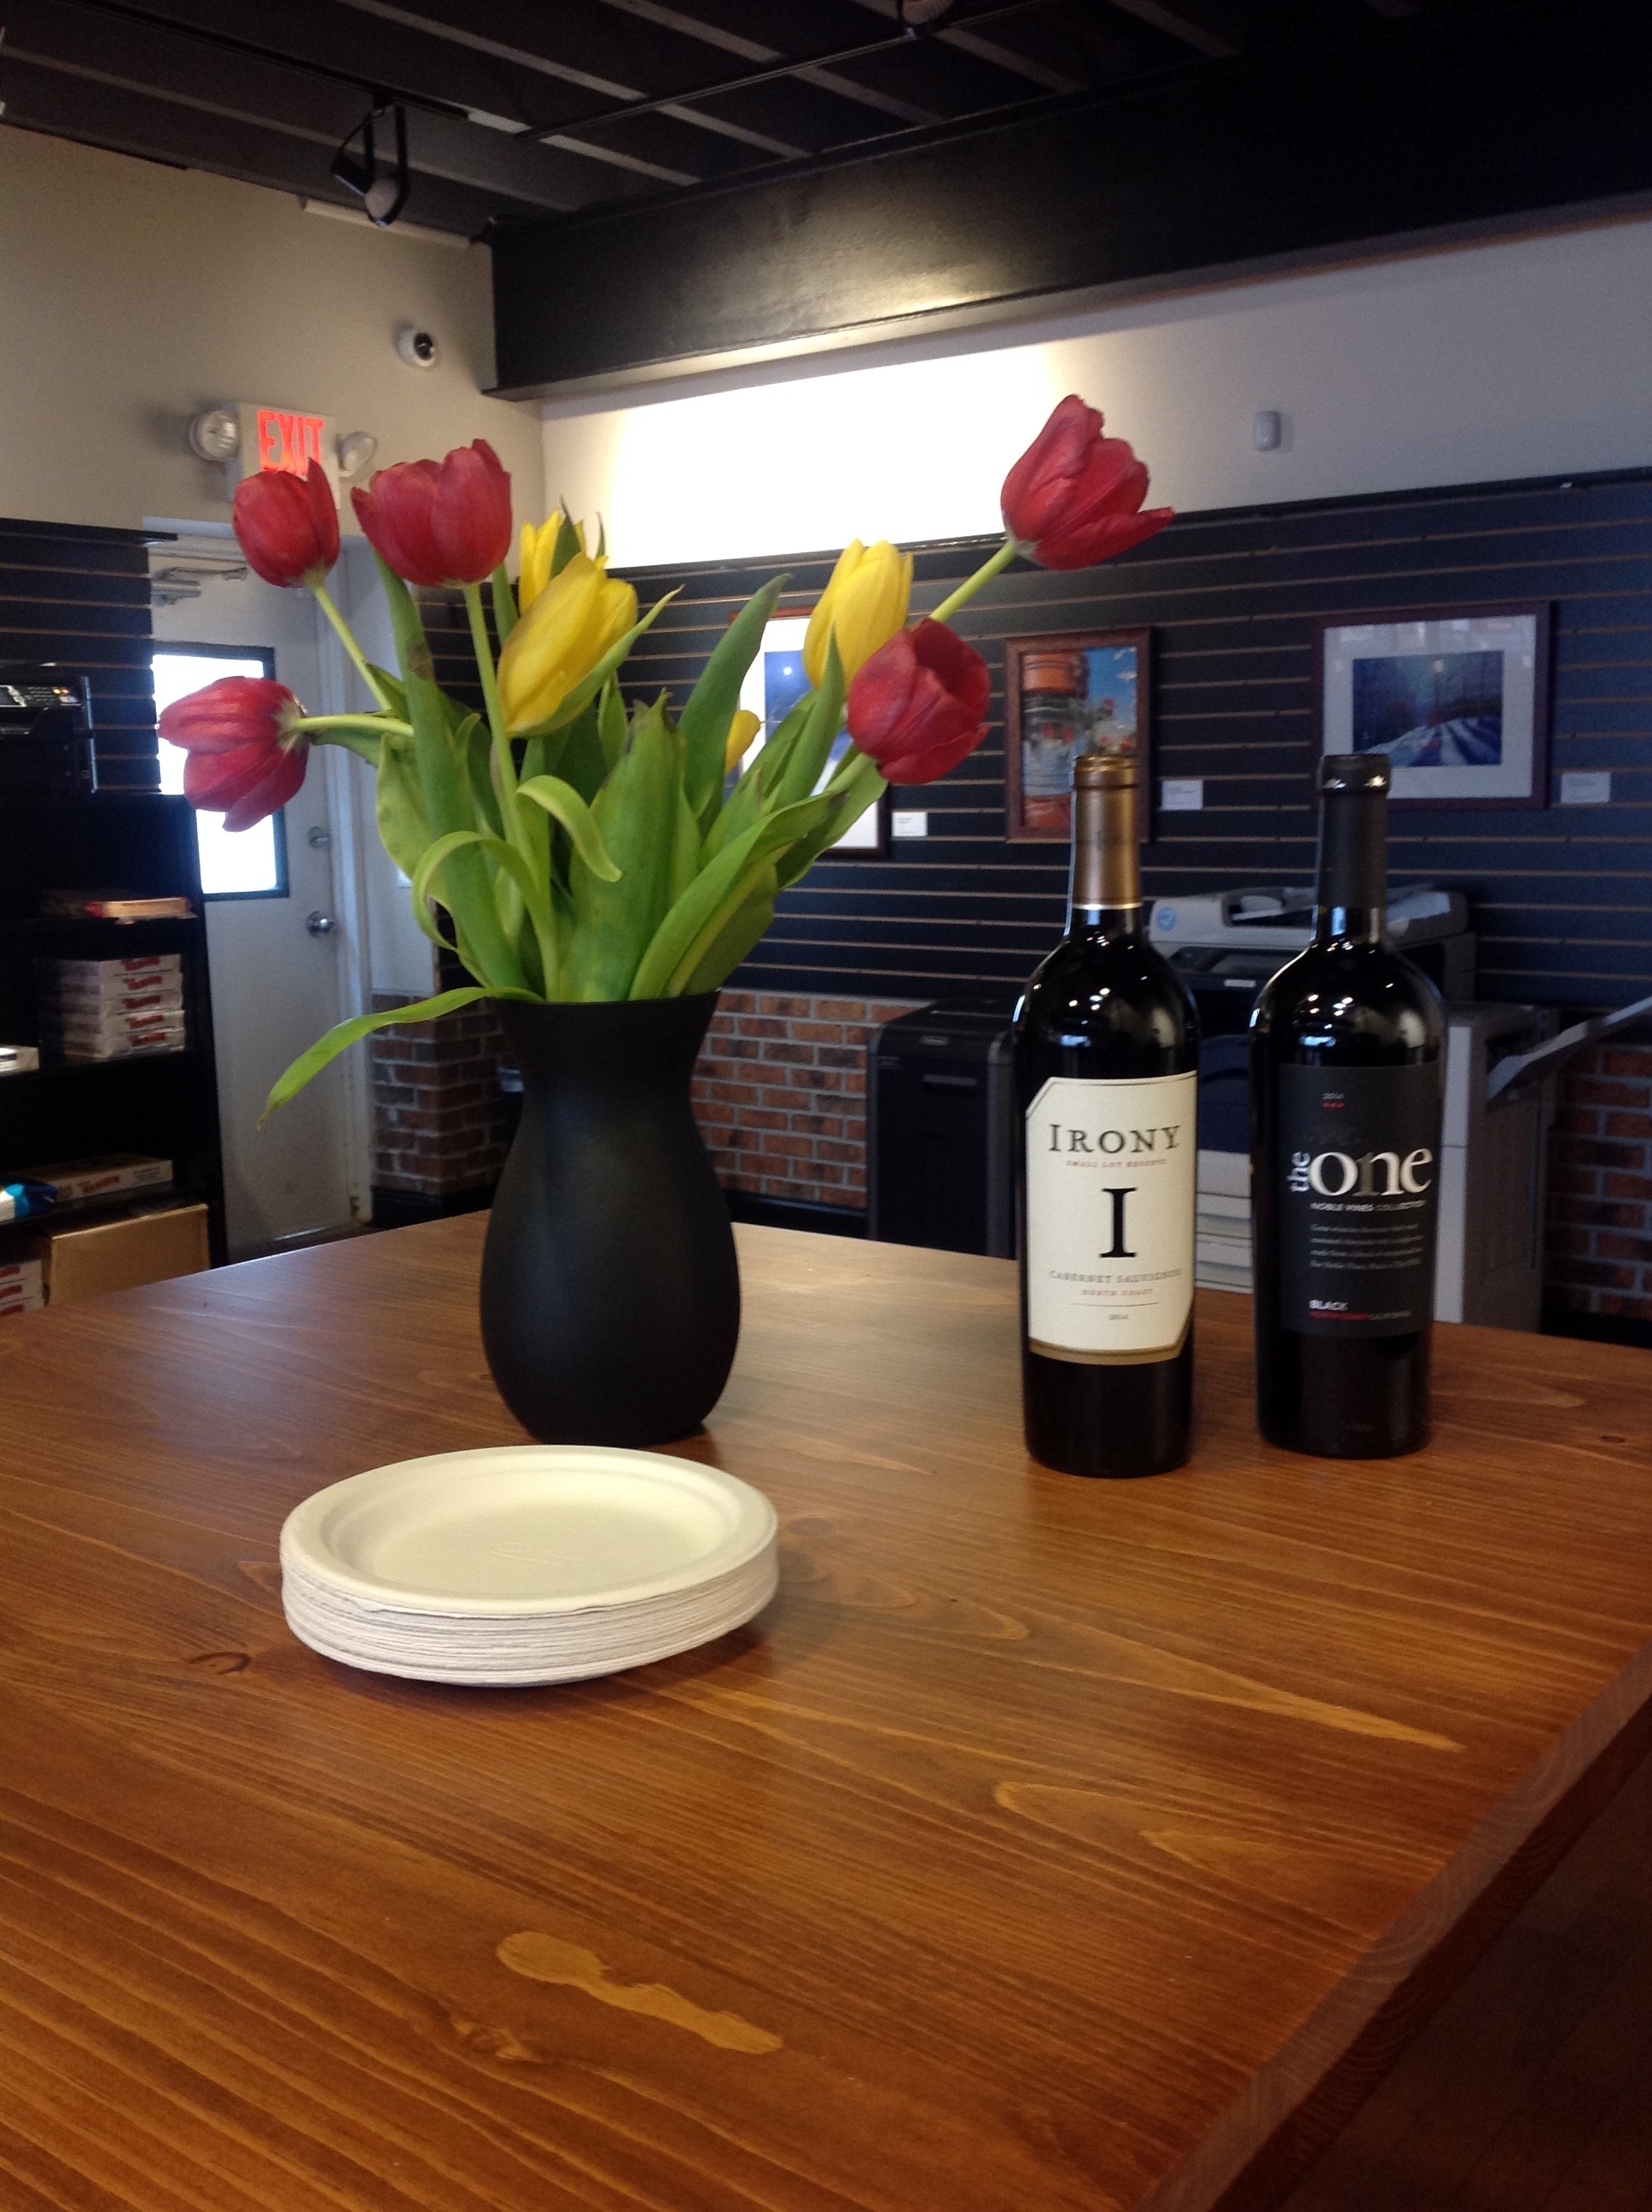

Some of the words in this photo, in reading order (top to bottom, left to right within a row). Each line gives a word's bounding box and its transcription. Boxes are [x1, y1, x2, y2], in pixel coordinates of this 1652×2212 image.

[258, 410, 324, 477] EXIT
[1049, 1123, 1181, 1154] IRONY
[1287, 1150, 1311, 1193] the
[1309, 1148, 1434, 1197] one
[1099, 1187, 1137, 1259] I
[1049, 1270, 1113, 1284] CABERNET
[1309, 1299, 1349, 1312] BLACK
